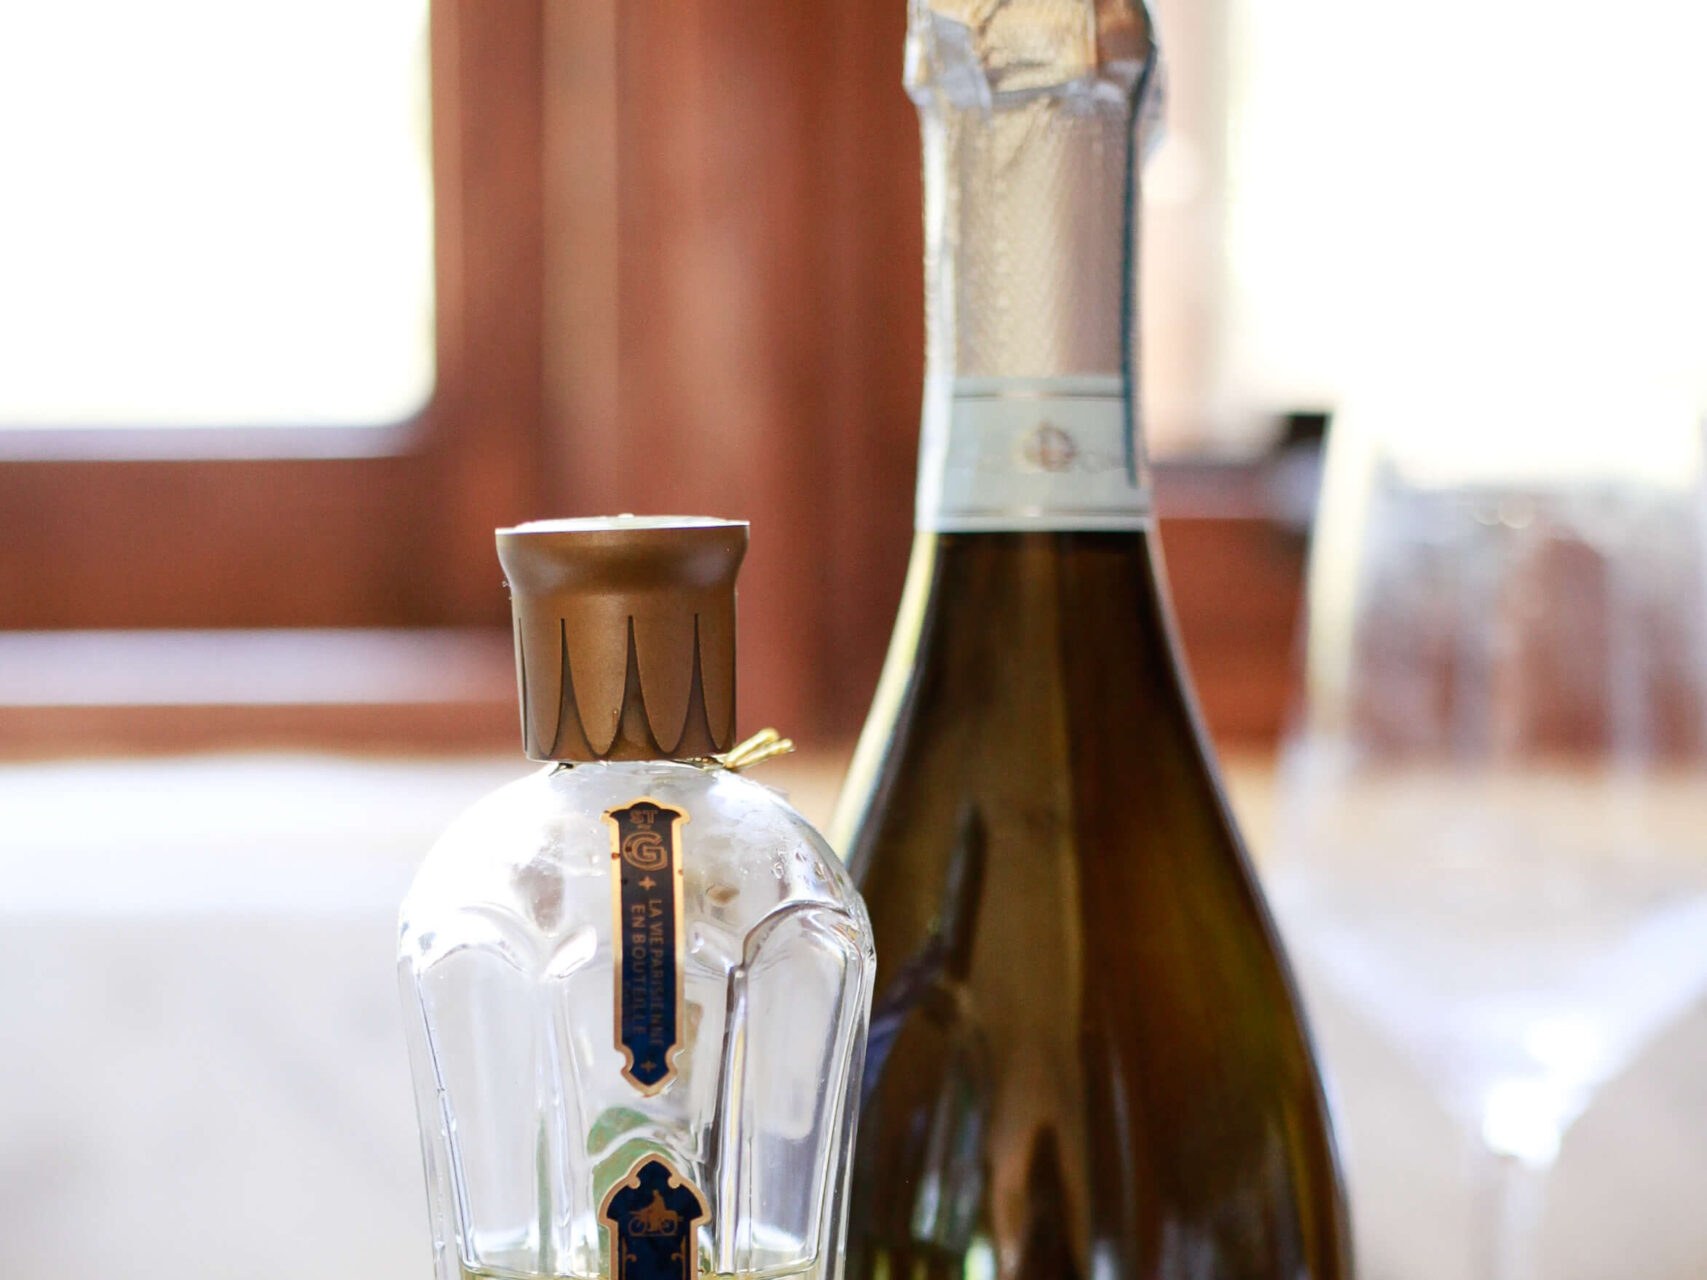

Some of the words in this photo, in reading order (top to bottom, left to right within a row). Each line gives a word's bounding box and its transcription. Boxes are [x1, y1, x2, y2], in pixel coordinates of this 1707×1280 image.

[632, 904, 646, 928] EN
[649, 899, 663, 917] LA
[650, 922, 664, 944] VIE
